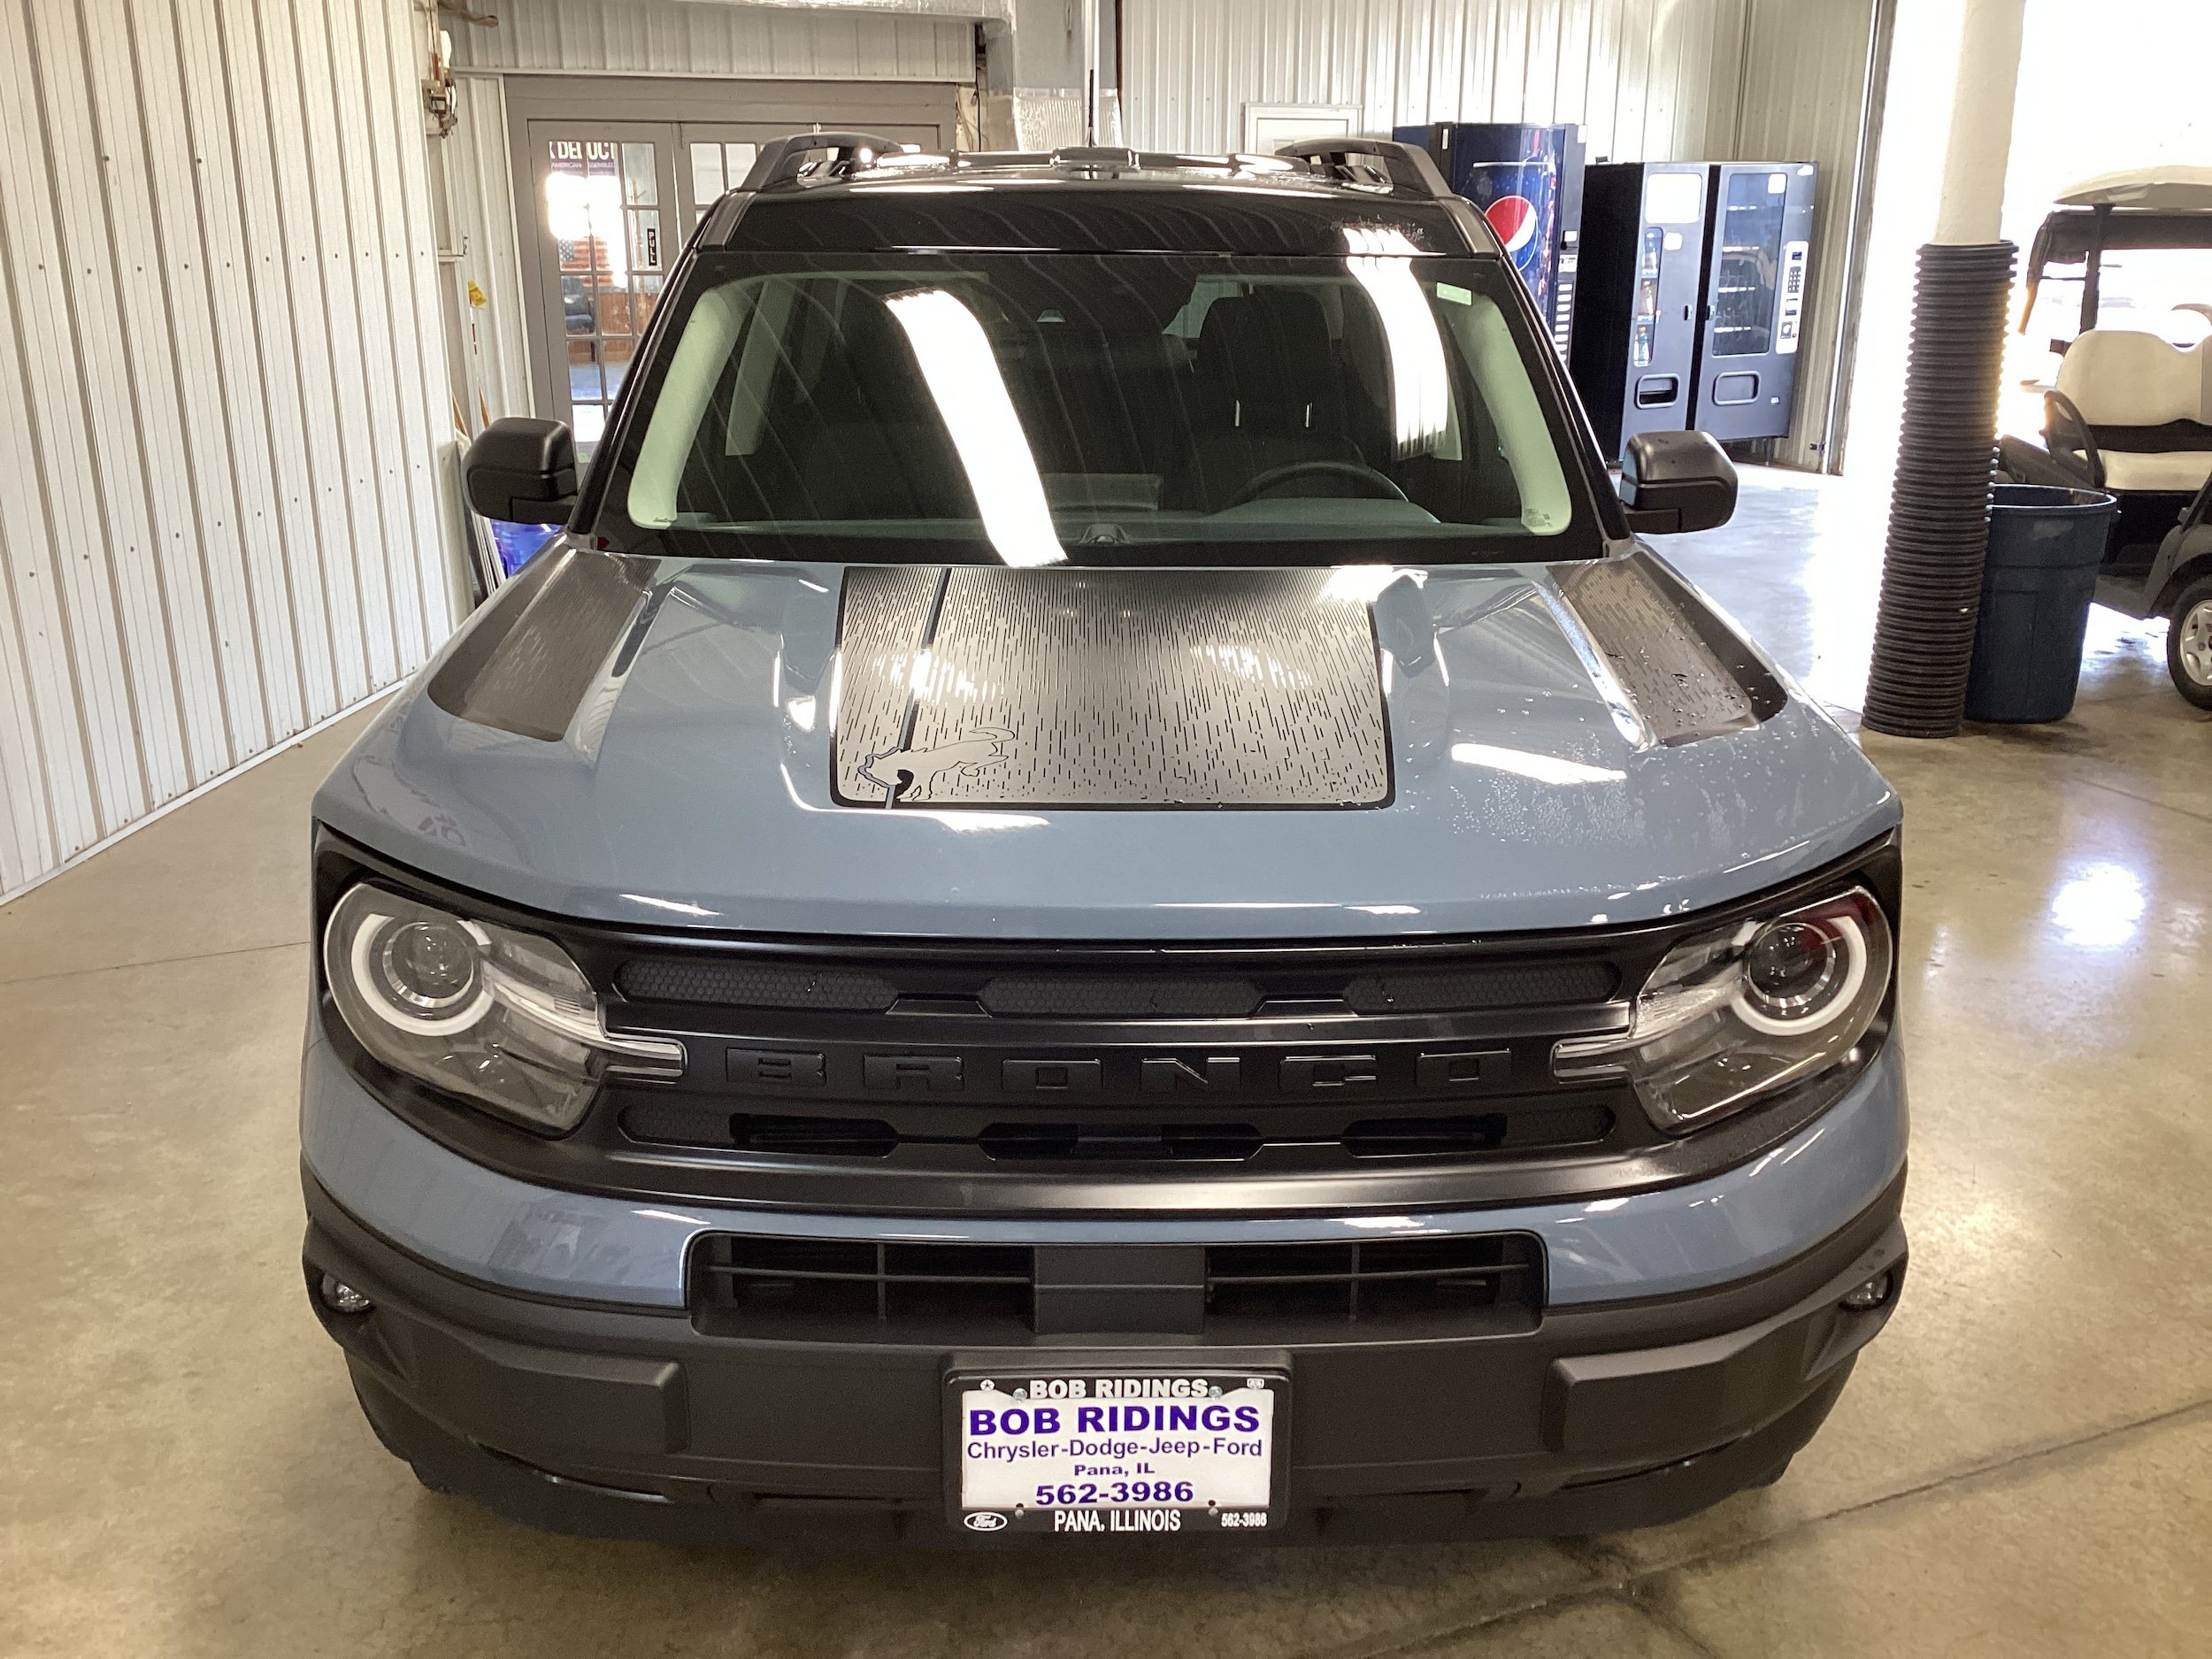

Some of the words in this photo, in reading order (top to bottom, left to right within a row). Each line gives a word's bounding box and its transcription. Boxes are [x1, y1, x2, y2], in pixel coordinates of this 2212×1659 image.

[648, 231, 657, 264] PULL
[725, 1048, 1512, 1093] BRONCO
[1030, 1379, 1087, 1399] BOB
[1095, 1379, 1209, 1398] RIDINGS
[970, 1408, 1061, 1436] BOB
[1078, 1405, 1260, 1432] RIDINGS
[967, 1437, 1262, 1463] Chrysler-Dodge-Jeep-Ford
[1074, 1464, 1129, 1477] Pana,
[1136, 1463, 1156, 1474] IL
[1035, 1481, 1194, 1505] 562-3986
[1054, 1510, 1105, 1532] PANA,
[1110, 1509, 1181, 1532] ILLINOIS
[1221, 1512, 1267, 1527] 562-3986
